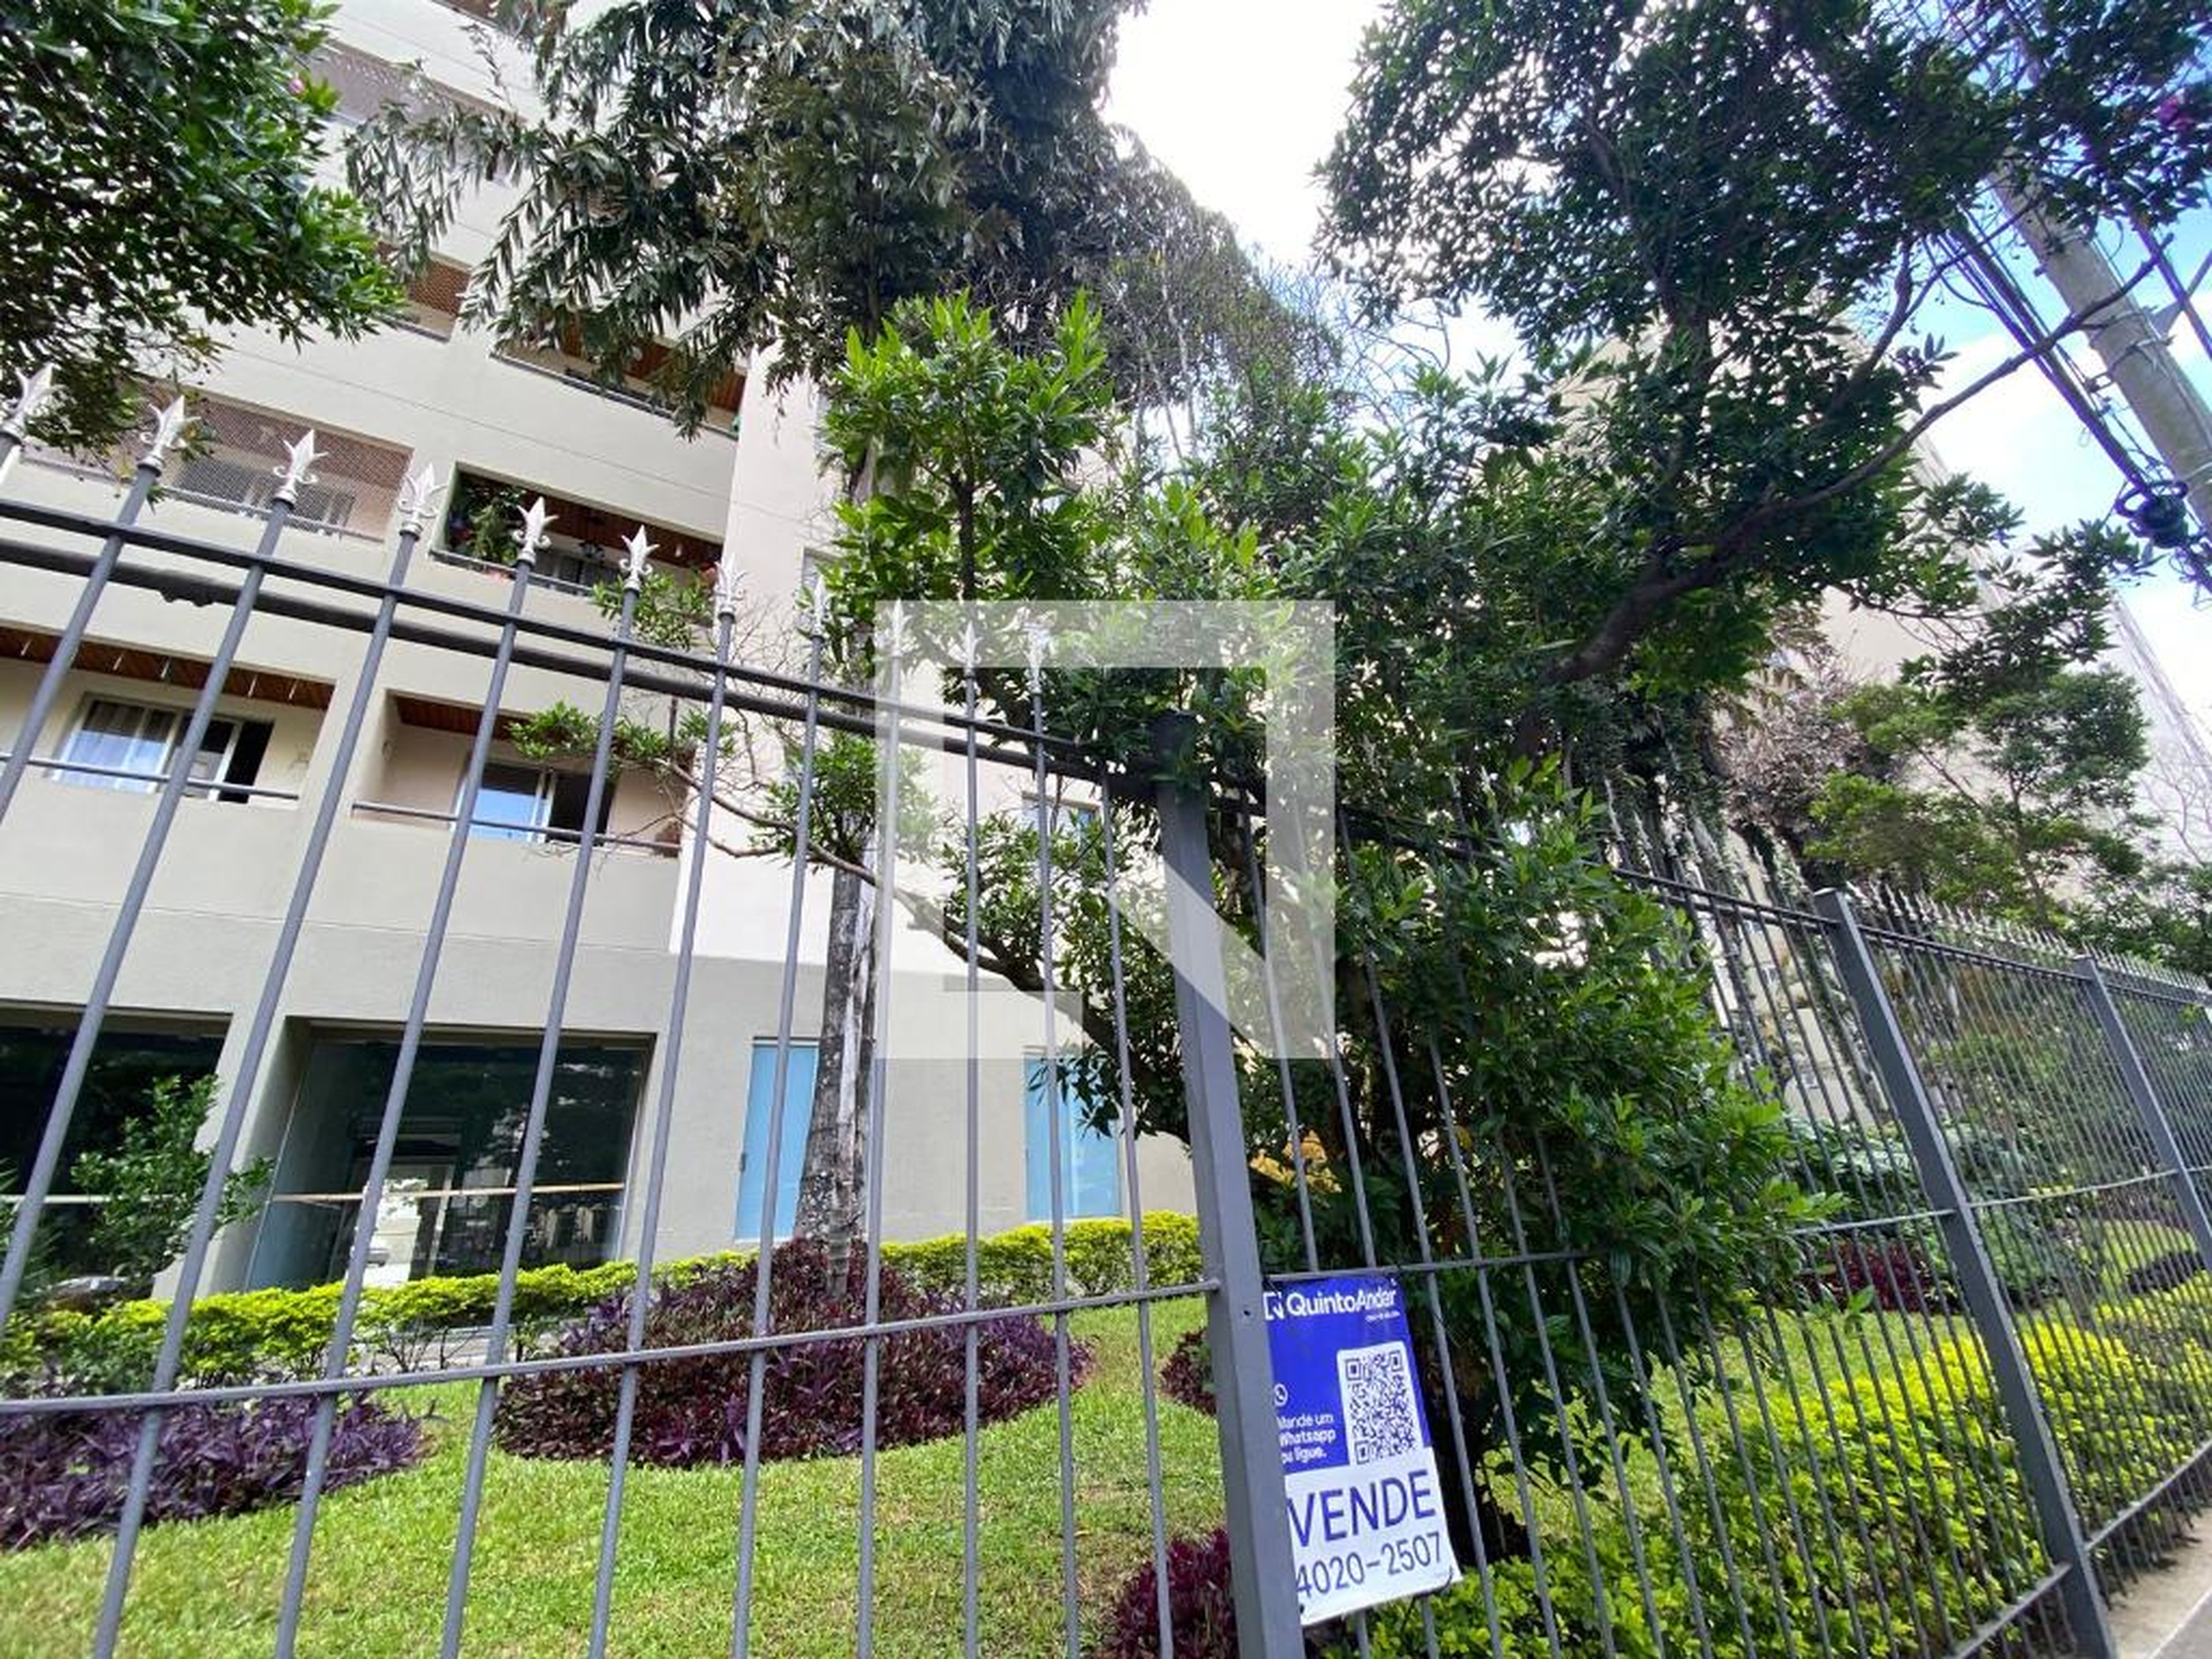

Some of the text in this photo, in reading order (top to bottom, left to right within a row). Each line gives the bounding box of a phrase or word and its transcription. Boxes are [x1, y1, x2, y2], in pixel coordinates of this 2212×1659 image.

[1315, 1414, 1334, 1426] um
[1287, 1469, 1435, 1547] VENDE
[1296, 1532, 1440, 1598] 4020-2507
